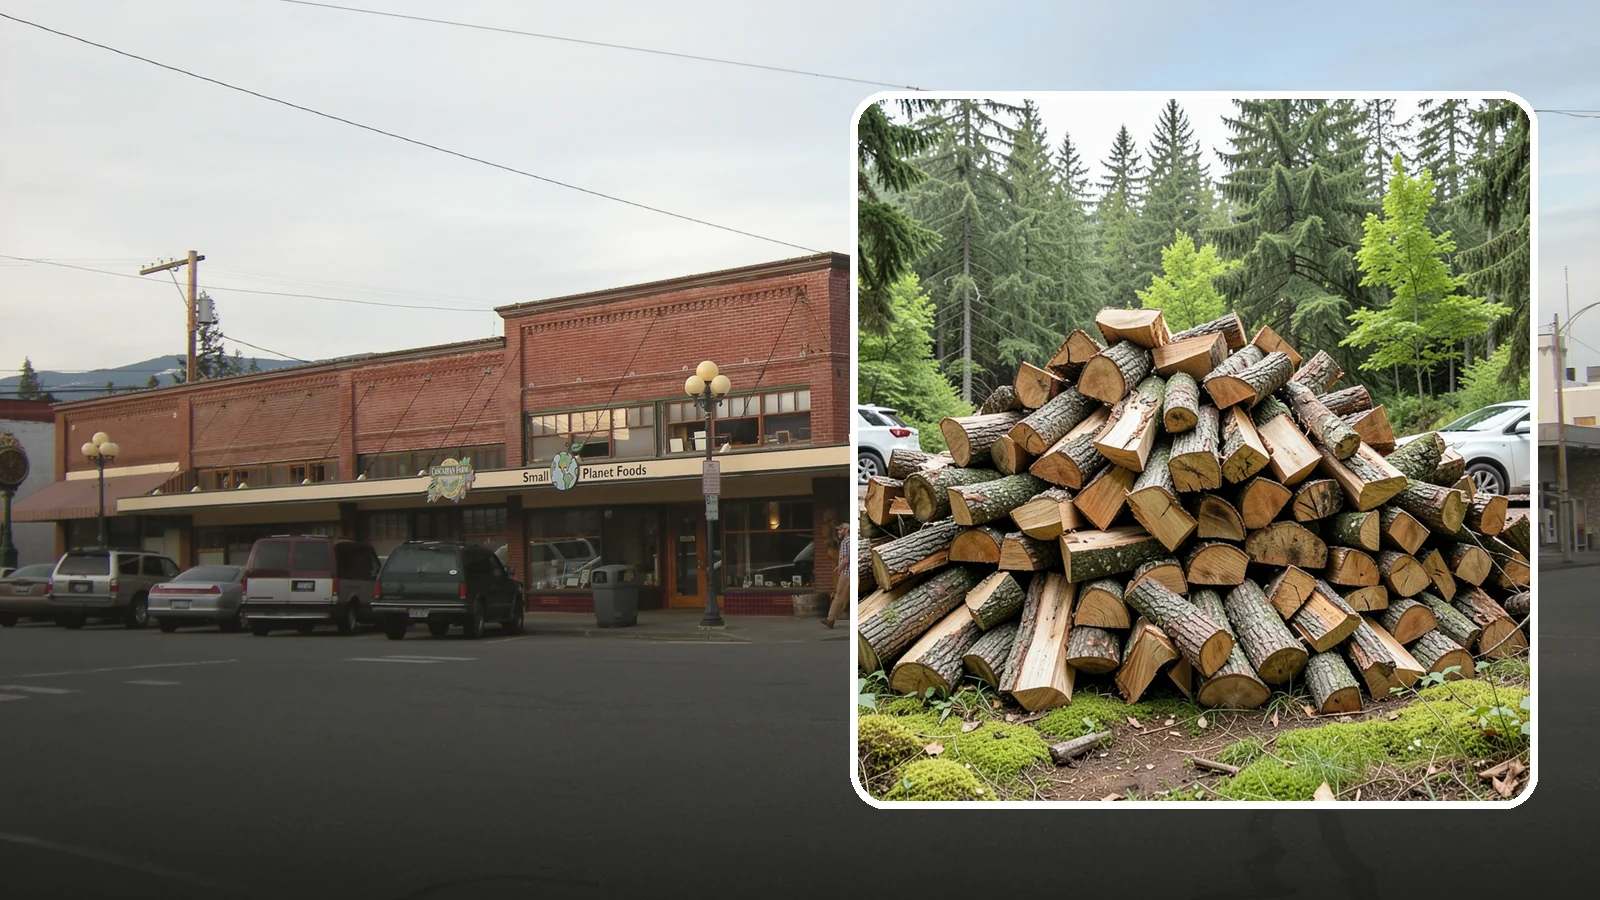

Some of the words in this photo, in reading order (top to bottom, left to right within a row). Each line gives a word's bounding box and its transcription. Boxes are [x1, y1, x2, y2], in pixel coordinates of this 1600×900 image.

[523, 471, 549, 483] Small
[583, 467, 614, 479] Planet
[617, 464, 647, 477] Foods
